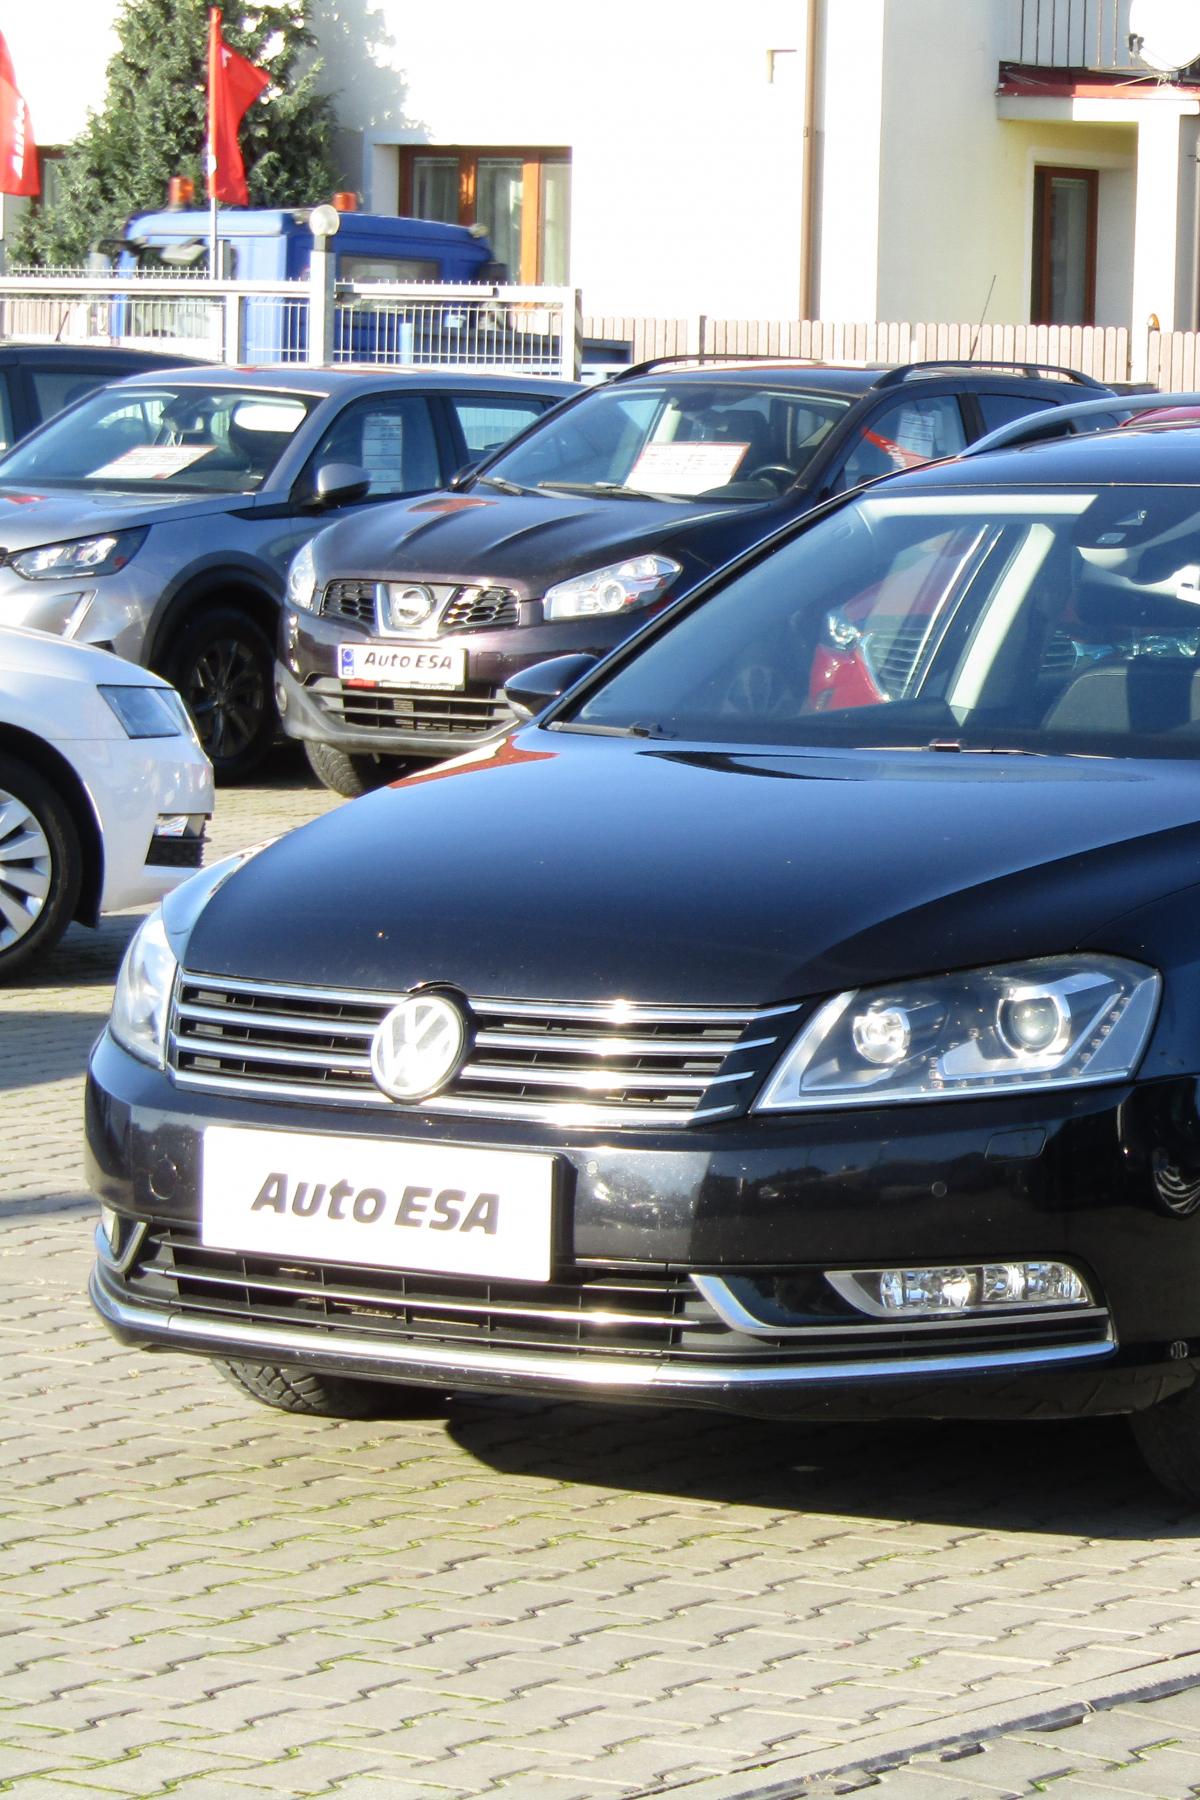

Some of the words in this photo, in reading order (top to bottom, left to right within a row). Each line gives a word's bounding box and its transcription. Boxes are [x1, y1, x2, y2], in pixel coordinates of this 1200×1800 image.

[364, 651, 411, 668] Auto
[415, 654, 453, 670] ESA
[250, 1172, 388, 1225] Auto
[394, 1185, 502, 1236] ESA
